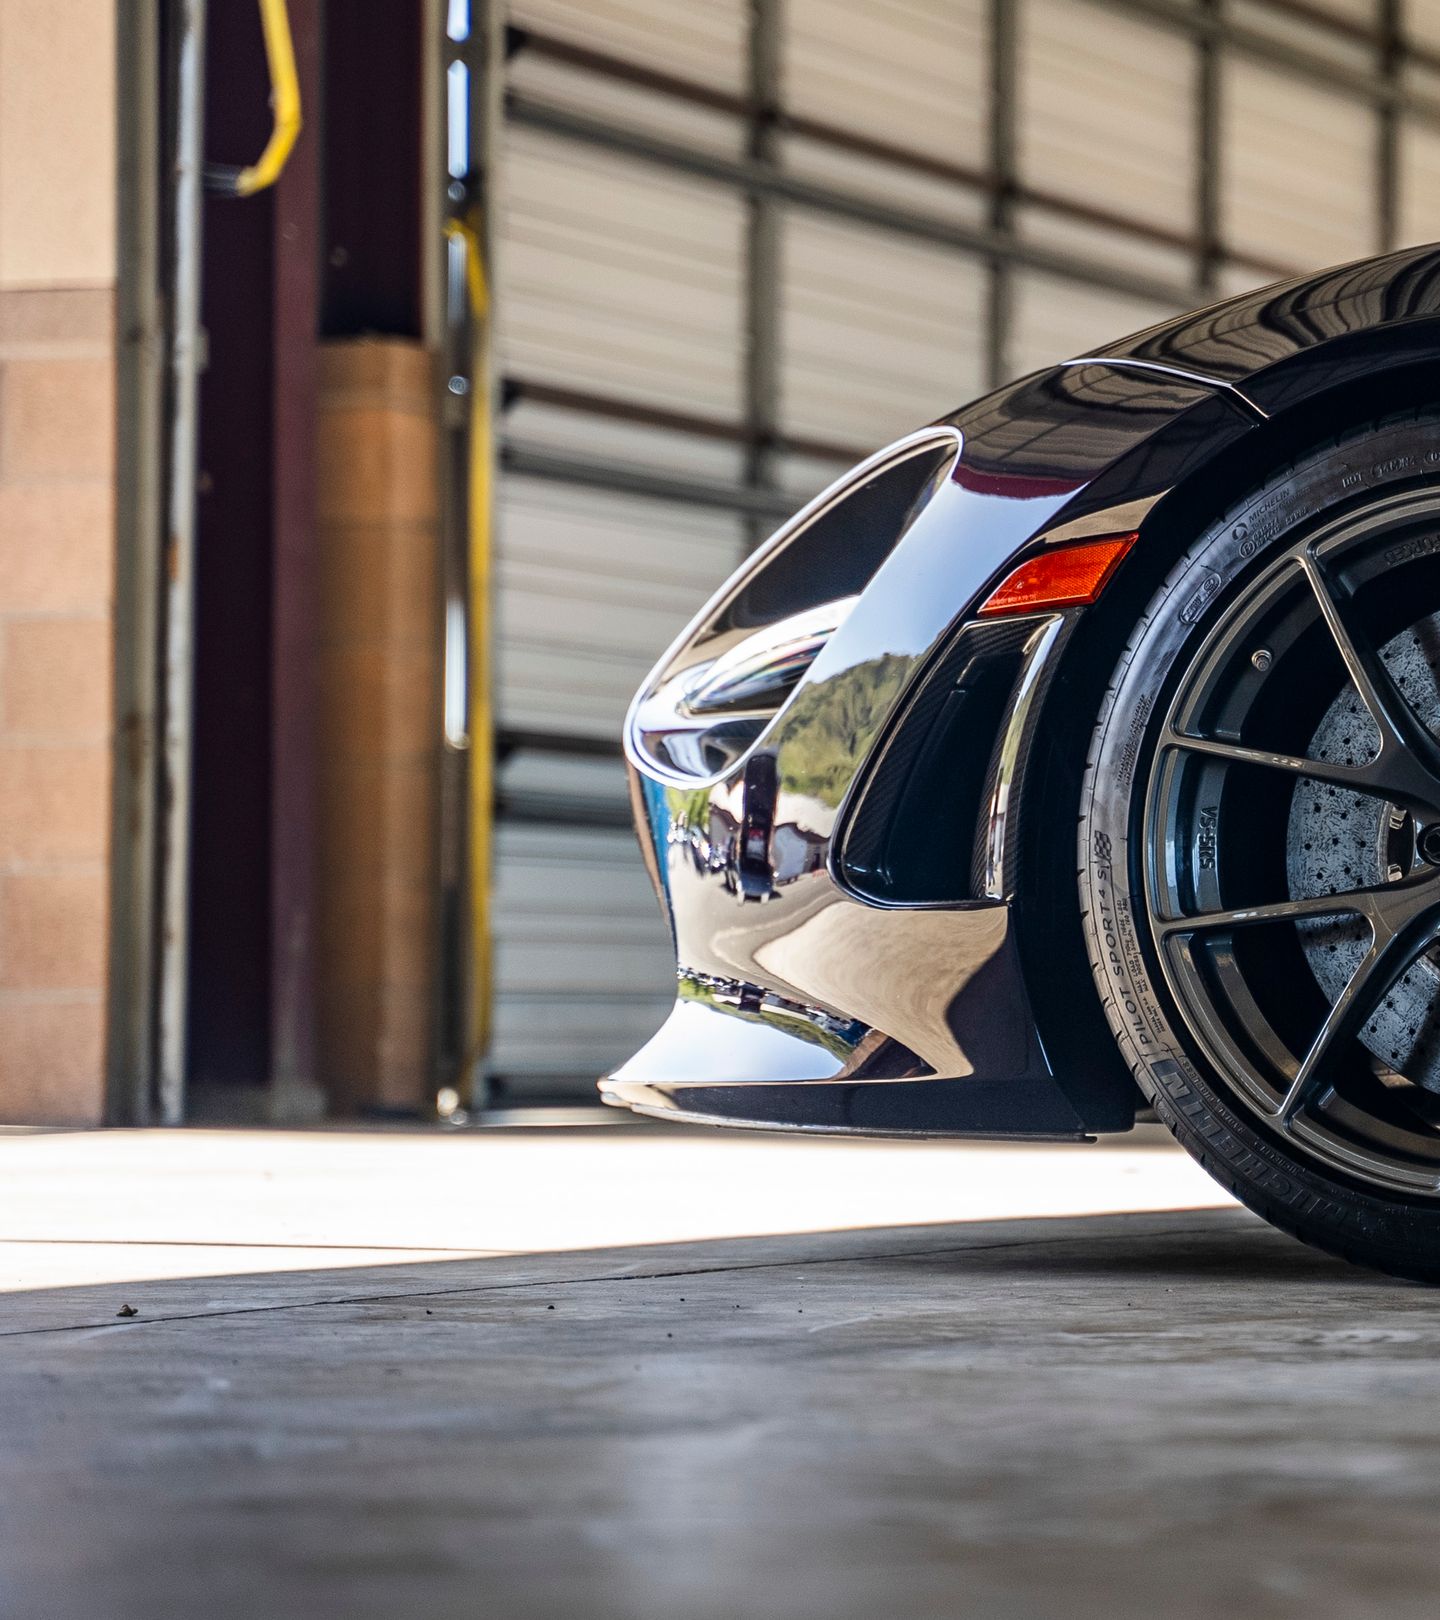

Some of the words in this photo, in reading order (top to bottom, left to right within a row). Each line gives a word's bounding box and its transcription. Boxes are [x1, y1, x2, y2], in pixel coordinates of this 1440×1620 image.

[1248, 488, 1291, 522] MICHELIN
[1199, 806, 1217, 869] VS-5RS
[1098, 888, 1106, 899] 4
[1100, 901, 1125, 977] SPORT
[1128, 959, 1138, 977] LOAD
[1119, 987, 1152, 1045] PILOT
[1161, 1071, 1347, 1226] MICHELIN
